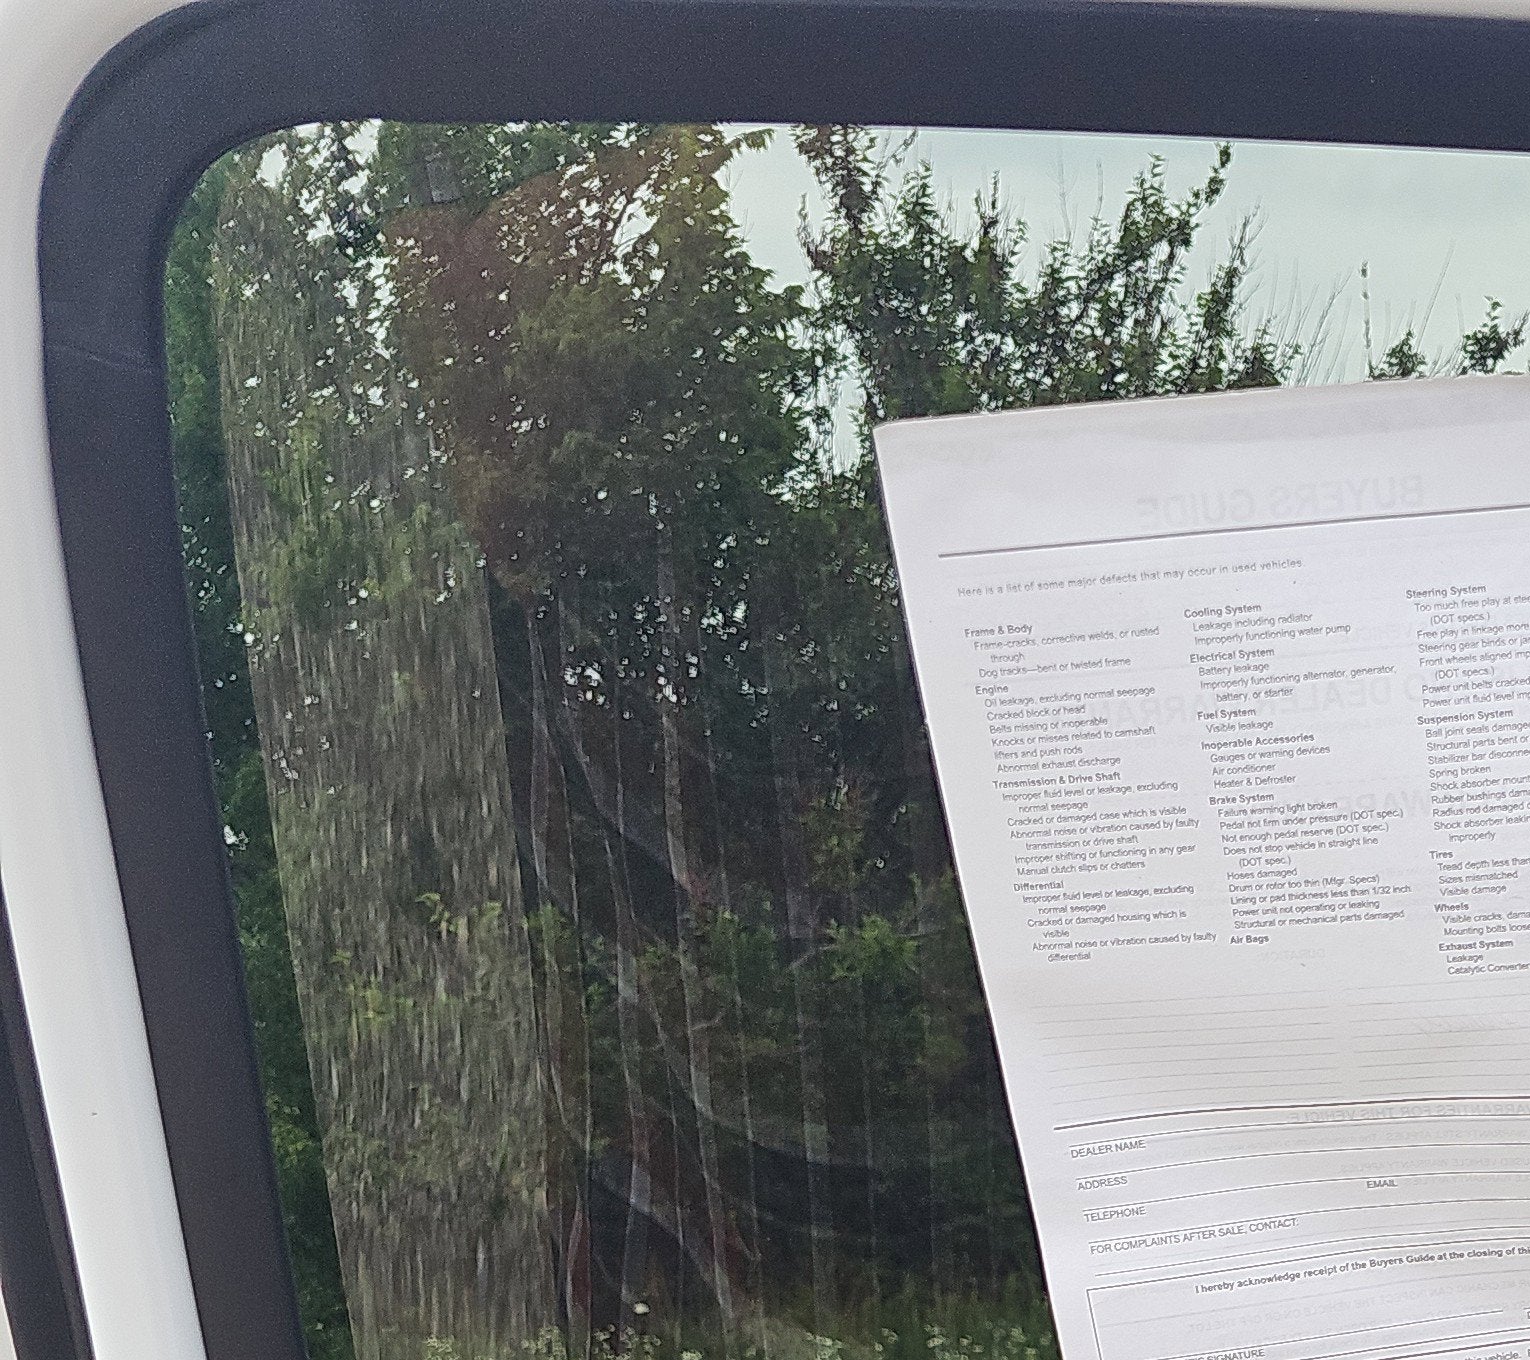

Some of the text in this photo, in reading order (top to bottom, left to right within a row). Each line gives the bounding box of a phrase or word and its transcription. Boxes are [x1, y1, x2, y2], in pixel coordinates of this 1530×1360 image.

[1405, 583, 1487, 601] Steering System
[1183, 602, 1262, 621] Cooling System
[964, 626, 996, 638] Frame
[1006, 623, 1033, 637] Body
[1189, 647, 1275, 663] Electrical System
[974, 683, 1009, 697] Engine
[1196, 706, 1257, 720] Fuel System
[1416, 708, 1514, 727] Suspension System
[1200, 732, 1315, 753] Inoperable Accessories
[992, 775, 1058, 789] Transmission
[1067, 773, 1094, 784] Drive
[1095, 771, 1122, 782] Shaft
[1208, 792, 1275, 806] Brake System
[1428, 849, 1454, 860] Tires
[1013, 879, 1065, 891] Differential
[1433, 901, 1470, 912] Wheels
[1245, 932, 1270, 945] Bags
[1438, 937, 1514, 951] Exhaust System
[1070, 1139, 1146, 1159] DEALER NAME
[1077, 1175, 1128, 1191] ADDRESS
[1366, 1177, 1398, 1189] EMAIL
[1083, 1205, 1147, 1222] TELEPHONE
[1090, 1242, 1113, 1254] FOR
[1113, 1233, 1181, 1251] COMPLAINTS
[1182, 1228, 1217, 1242] AFTER
[1200, 1278, 1236, 1295] hereby
[1236, 1268, 1302, 1290] acknowledge
[1302, 1263, 1338, 1280] receipt
[1350, 1258, 1368, 1270] the
[1368, 1253, 1405, 1270] Buyers
[1405, 1251, 1436, 1263] Guide
[1448, 1249, 1466, 1260] the
[1466, 1246, 1504, 1261] closing
